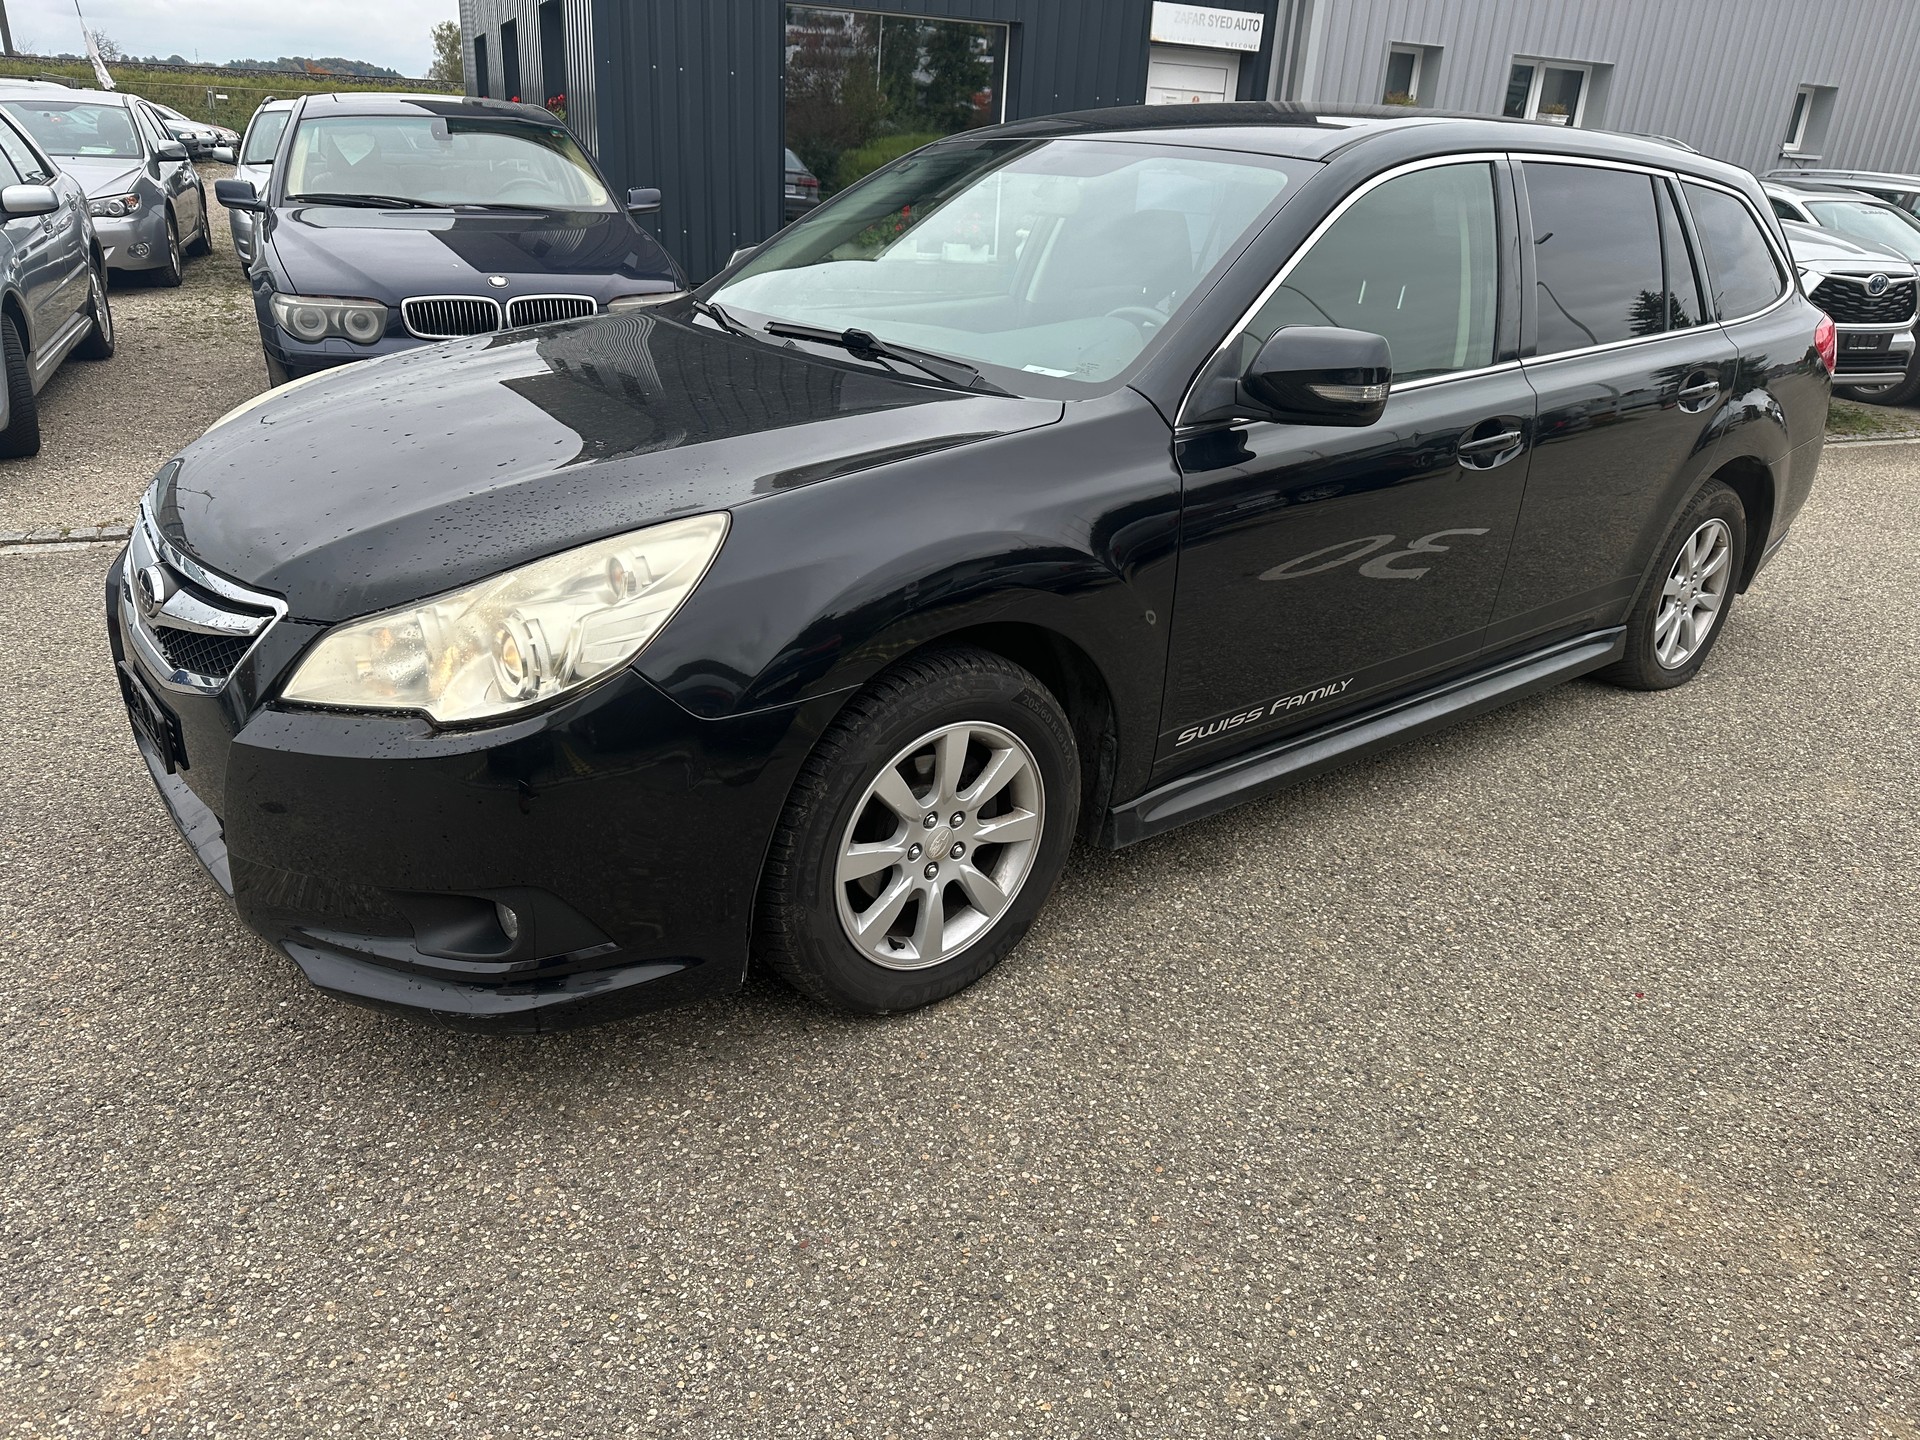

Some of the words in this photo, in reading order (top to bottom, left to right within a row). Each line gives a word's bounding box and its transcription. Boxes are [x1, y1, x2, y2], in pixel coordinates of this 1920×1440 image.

[1174, 11, 1205, 26] ZAFAR
[1208, 14, 1233, 29] SYED
[1234, 17, 1260, 32] AUTO
[1225, 42, 1257, 50] WELCOME
[1022, 695, 1052, 723] 205/60
[1051, 721, 1065, 742] R16
[1175, 706, 1265, 747] SWISS
[1269, 677, 1354, 715] FAMILY
